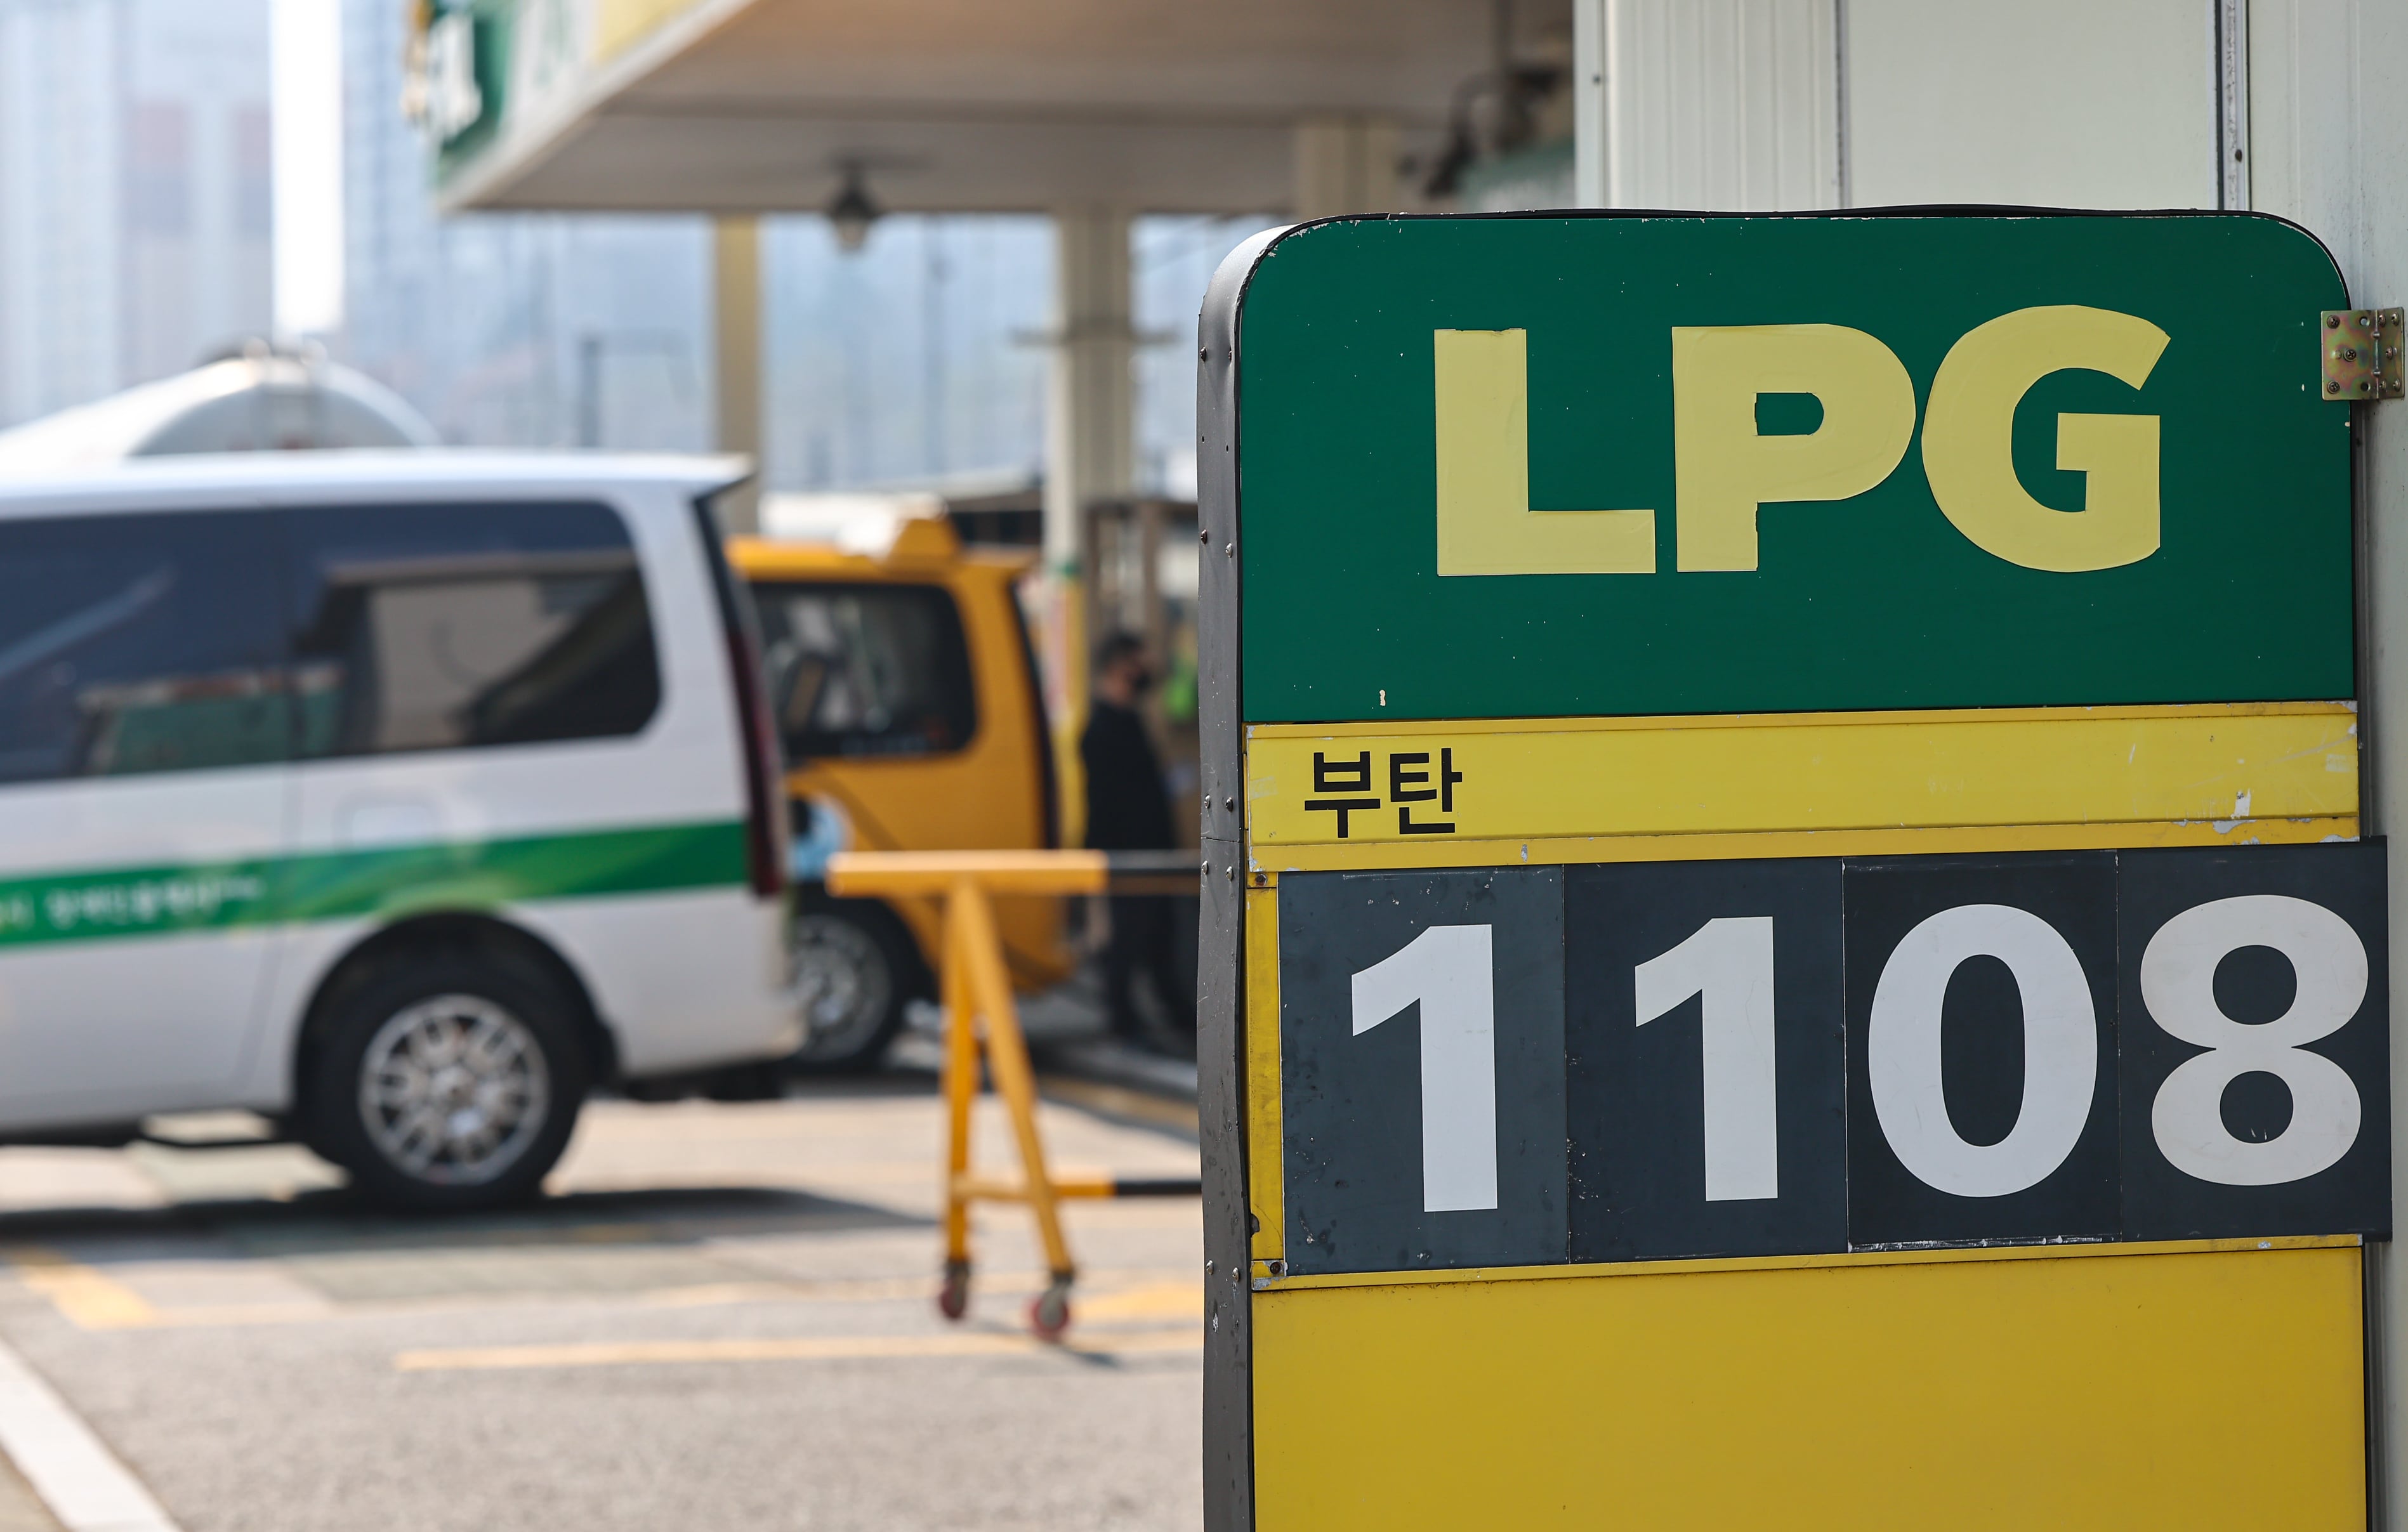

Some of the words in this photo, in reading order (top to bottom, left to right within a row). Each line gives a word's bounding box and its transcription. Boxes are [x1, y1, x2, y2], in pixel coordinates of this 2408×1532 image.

[1435, 305, 2171, 576] LPG
[1304, 747, 1463, 838] 부탄
[1351, 894, 2369, 1212] 1108
